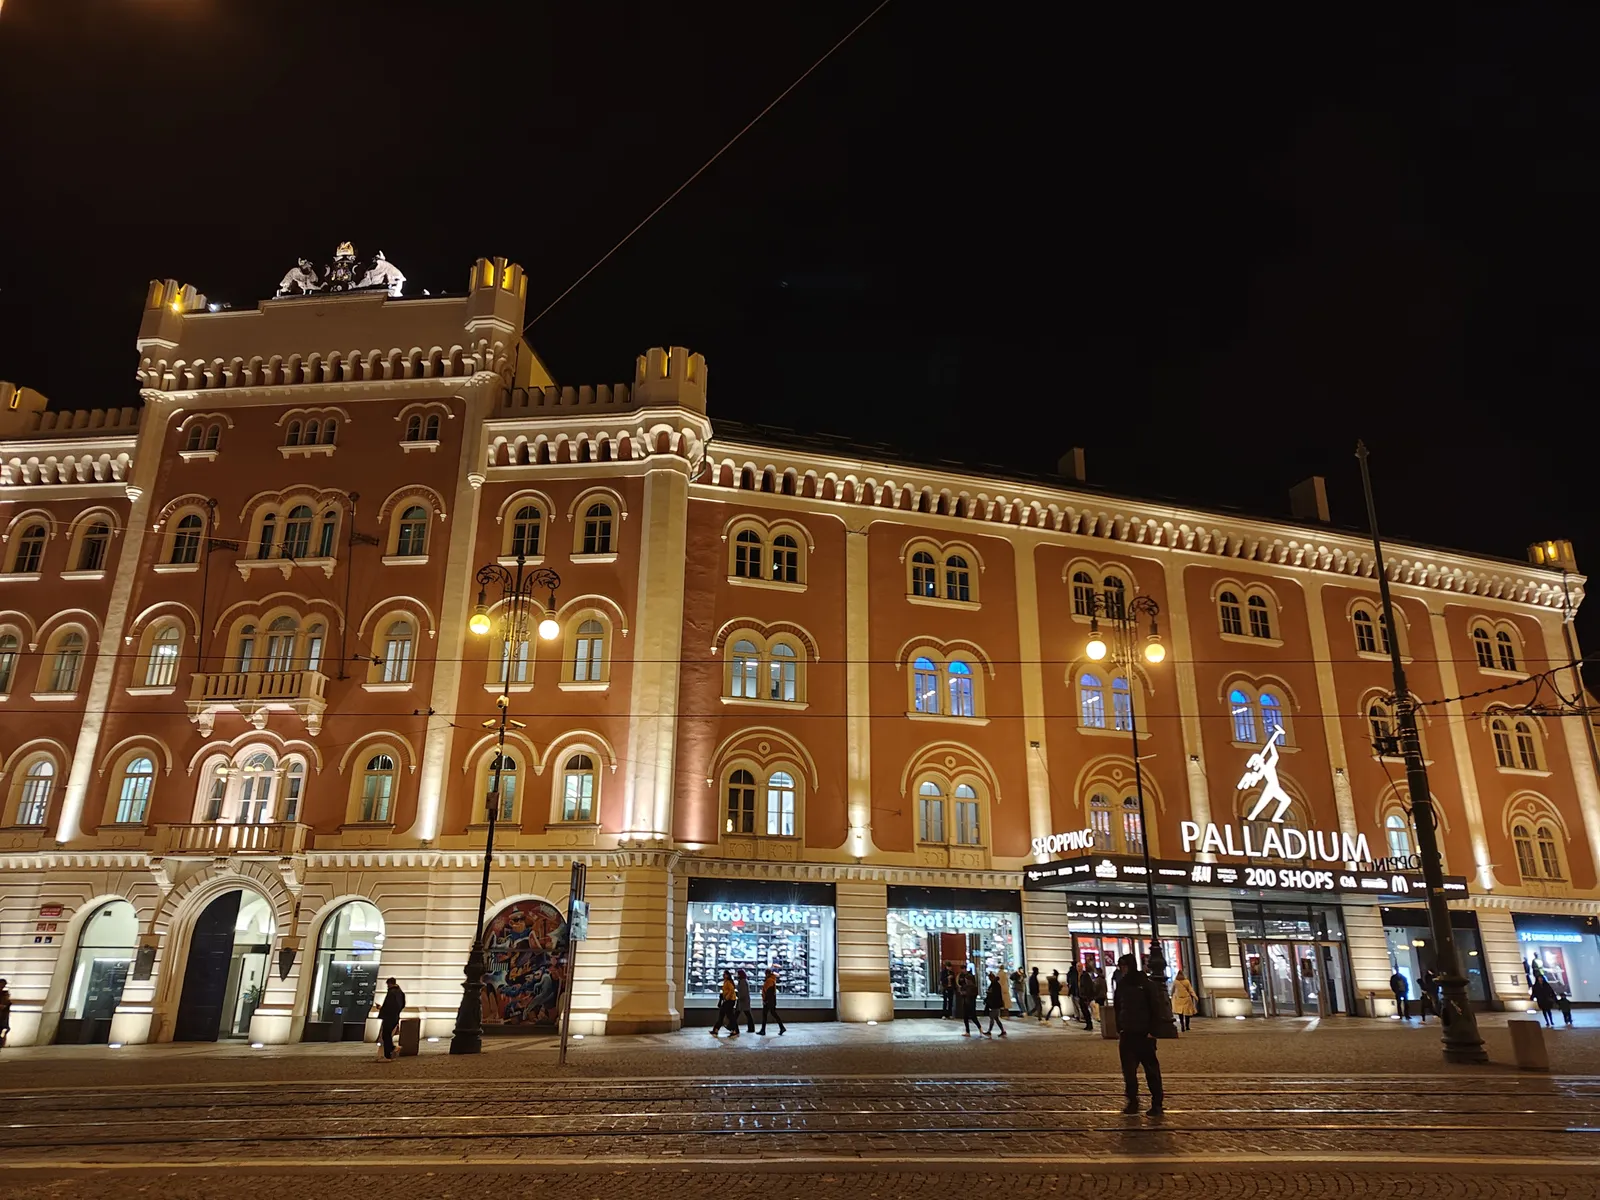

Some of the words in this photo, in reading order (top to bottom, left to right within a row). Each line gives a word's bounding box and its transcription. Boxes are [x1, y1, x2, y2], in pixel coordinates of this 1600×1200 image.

[1031, 828, 1094, 856] SHOPPING
[1180, 821, 1372, 863] PALLADIUM
[1244, 867, 1277, 887] 200
[1279, 869, 1335, 890] SHOPS
[712, 904, 750, 922] Foot
[754, 905, 810, 925] Locker
[908, 910, 944, 928] Foot
[946, 911, 998, 929] Locker
